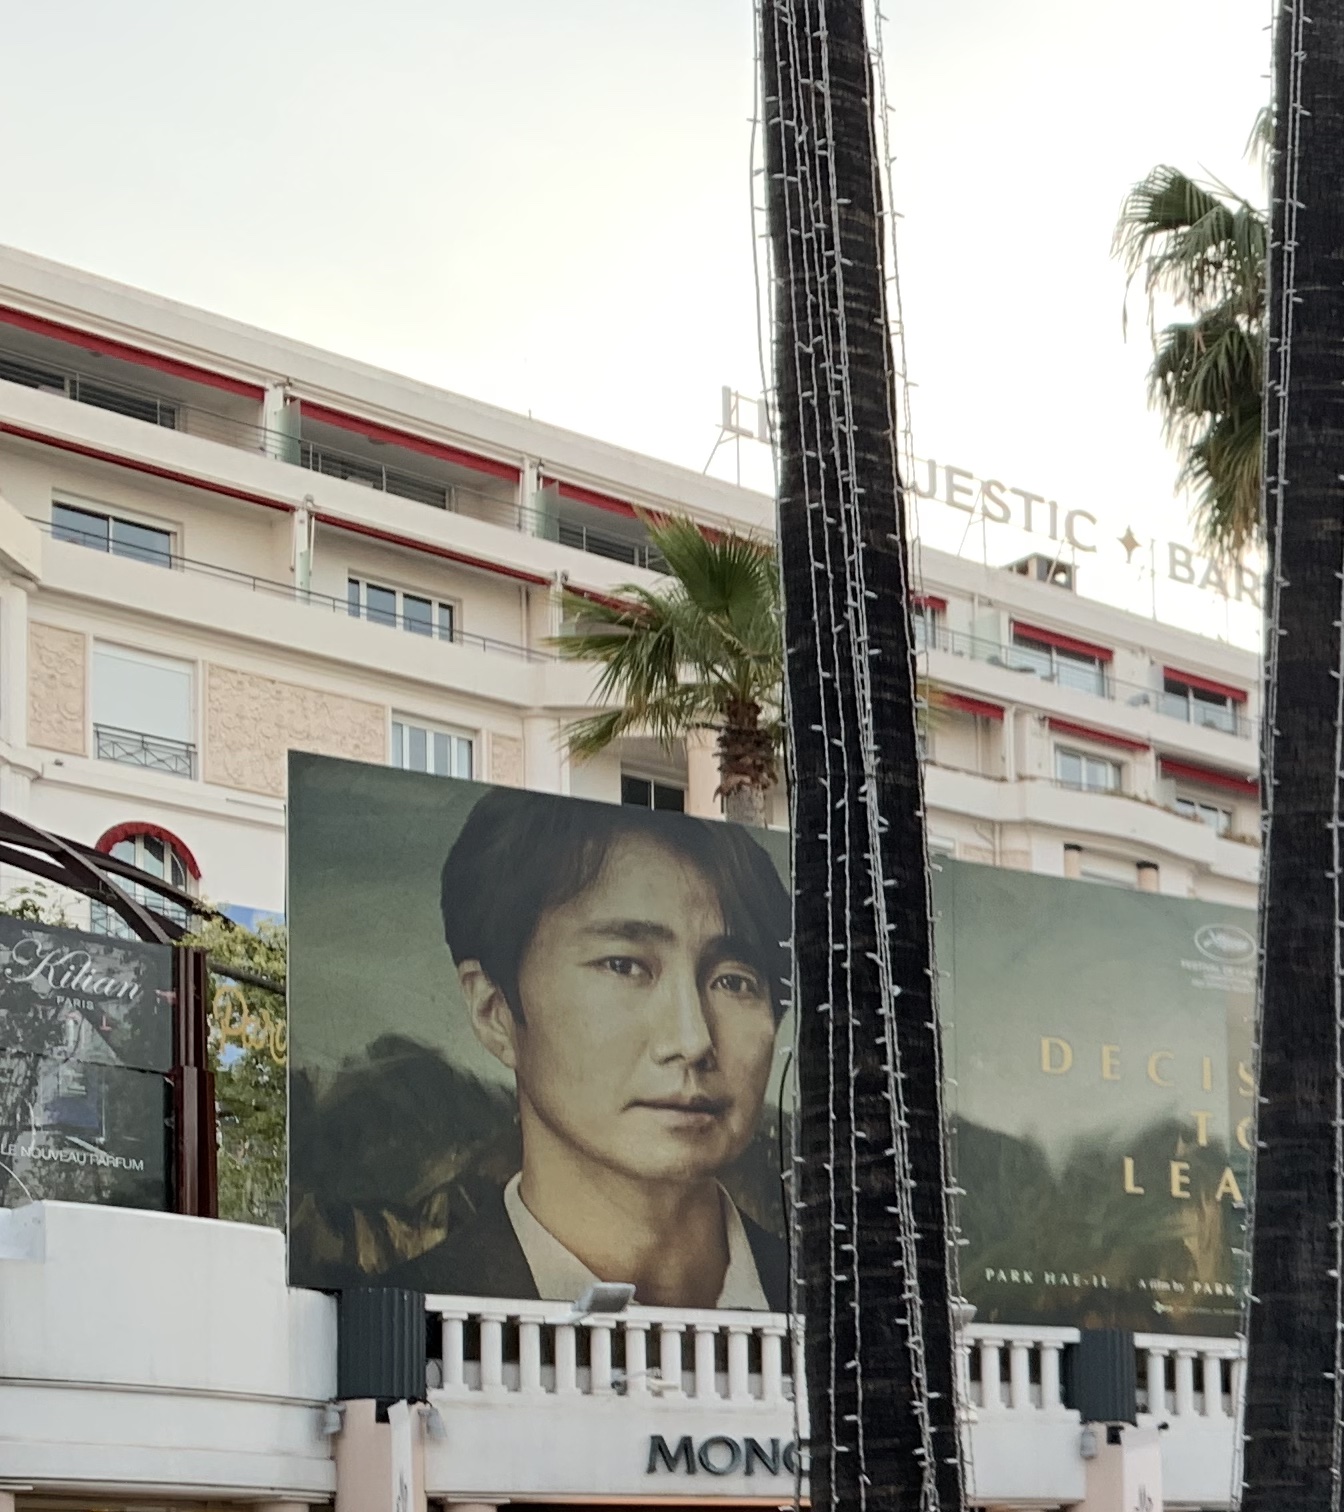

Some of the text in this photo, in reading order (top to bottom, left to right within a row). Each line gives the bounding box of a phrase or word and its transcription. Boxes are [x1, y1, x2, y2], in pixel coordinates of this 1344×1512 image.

[911, 457, 1097, 553] JESTIC
[4, 938, 140, 1000] Kilian
[57, 996, 94, 1011] PARIS
[20, 1145, 87, 1165] NOUVEAU
[89, 1150, 145, 1171] PARFUM
[1123, 1156, 1244, 1203] LEA
[984, 1267, 1033, 1284] PARK
[1192, 1280, 1235, 1296] PARK
[646, 1434, 810, 1477] MONC
